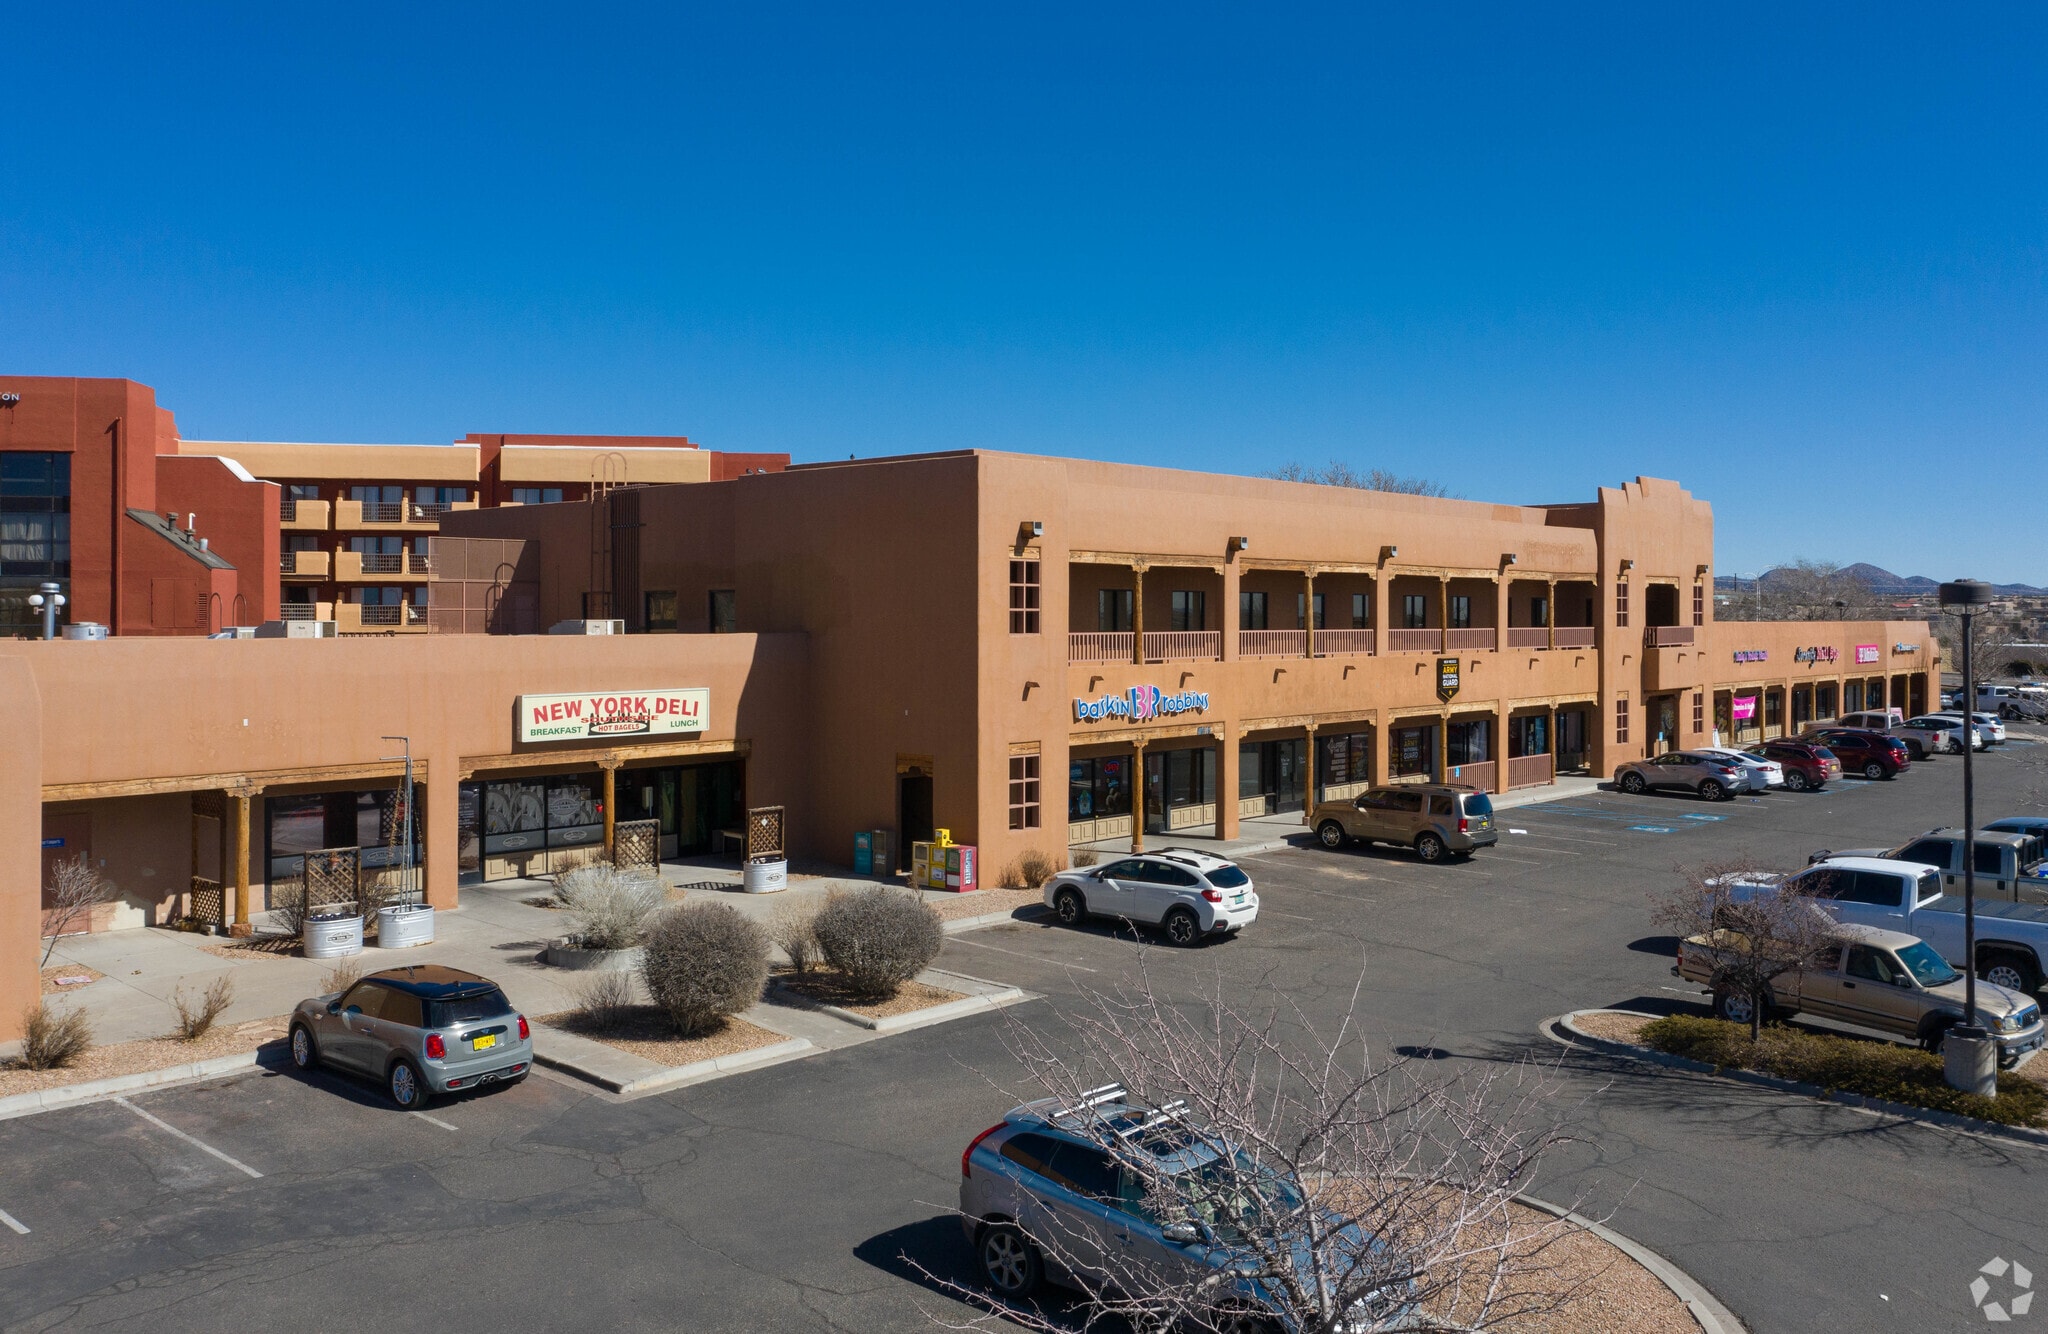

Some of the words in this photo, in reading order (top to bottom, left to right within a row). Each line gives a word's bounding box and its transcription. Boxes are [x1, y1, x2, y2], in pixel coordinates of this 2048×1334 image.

[1443, 679, 1458, 687] GUARD
[1077, 695, 1130, 718] baskin
[1163, 691, 1209, 712] robbins
[533, 700, 582, 725] NEW
[590, 697, 648, 715] YORK
[655, 697, 699, 717] DELI
[580, 714, 659, 724] SOUTHSIDE
[670, 719, 699, 728] LUNCH
[530, 726, 582, 737] BREAKFAST
[598, 724, 613, 732] HOT
[614, 723, 640, 731] BAGELS
